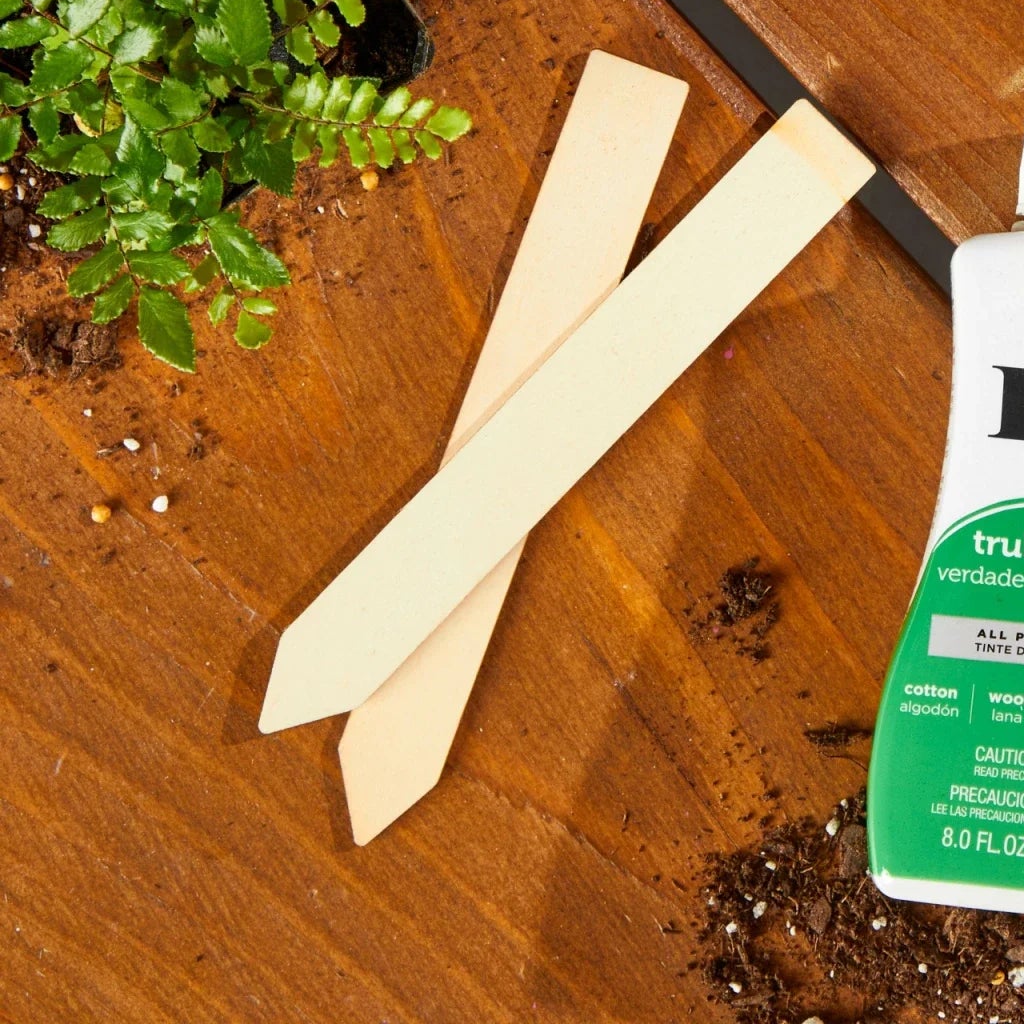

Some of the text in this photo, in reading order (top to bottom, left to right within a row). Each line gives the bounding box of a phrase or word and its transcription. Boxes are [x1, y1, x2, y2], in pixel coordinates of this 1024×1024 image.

[977, 629, 1007, 640] ALL
[975, 643, 1012, 654] TINTE
[904, 683, 958, 700] cotton
[899, 700, 959, 719] algodón
[992, 709, 1023, 724] lana
[974, 766, 998, 778] READ
[931, 803, 948, 814] LEE
[950, 805, 967, 817] LAS
[942, 827, 971, 849] 8.0
